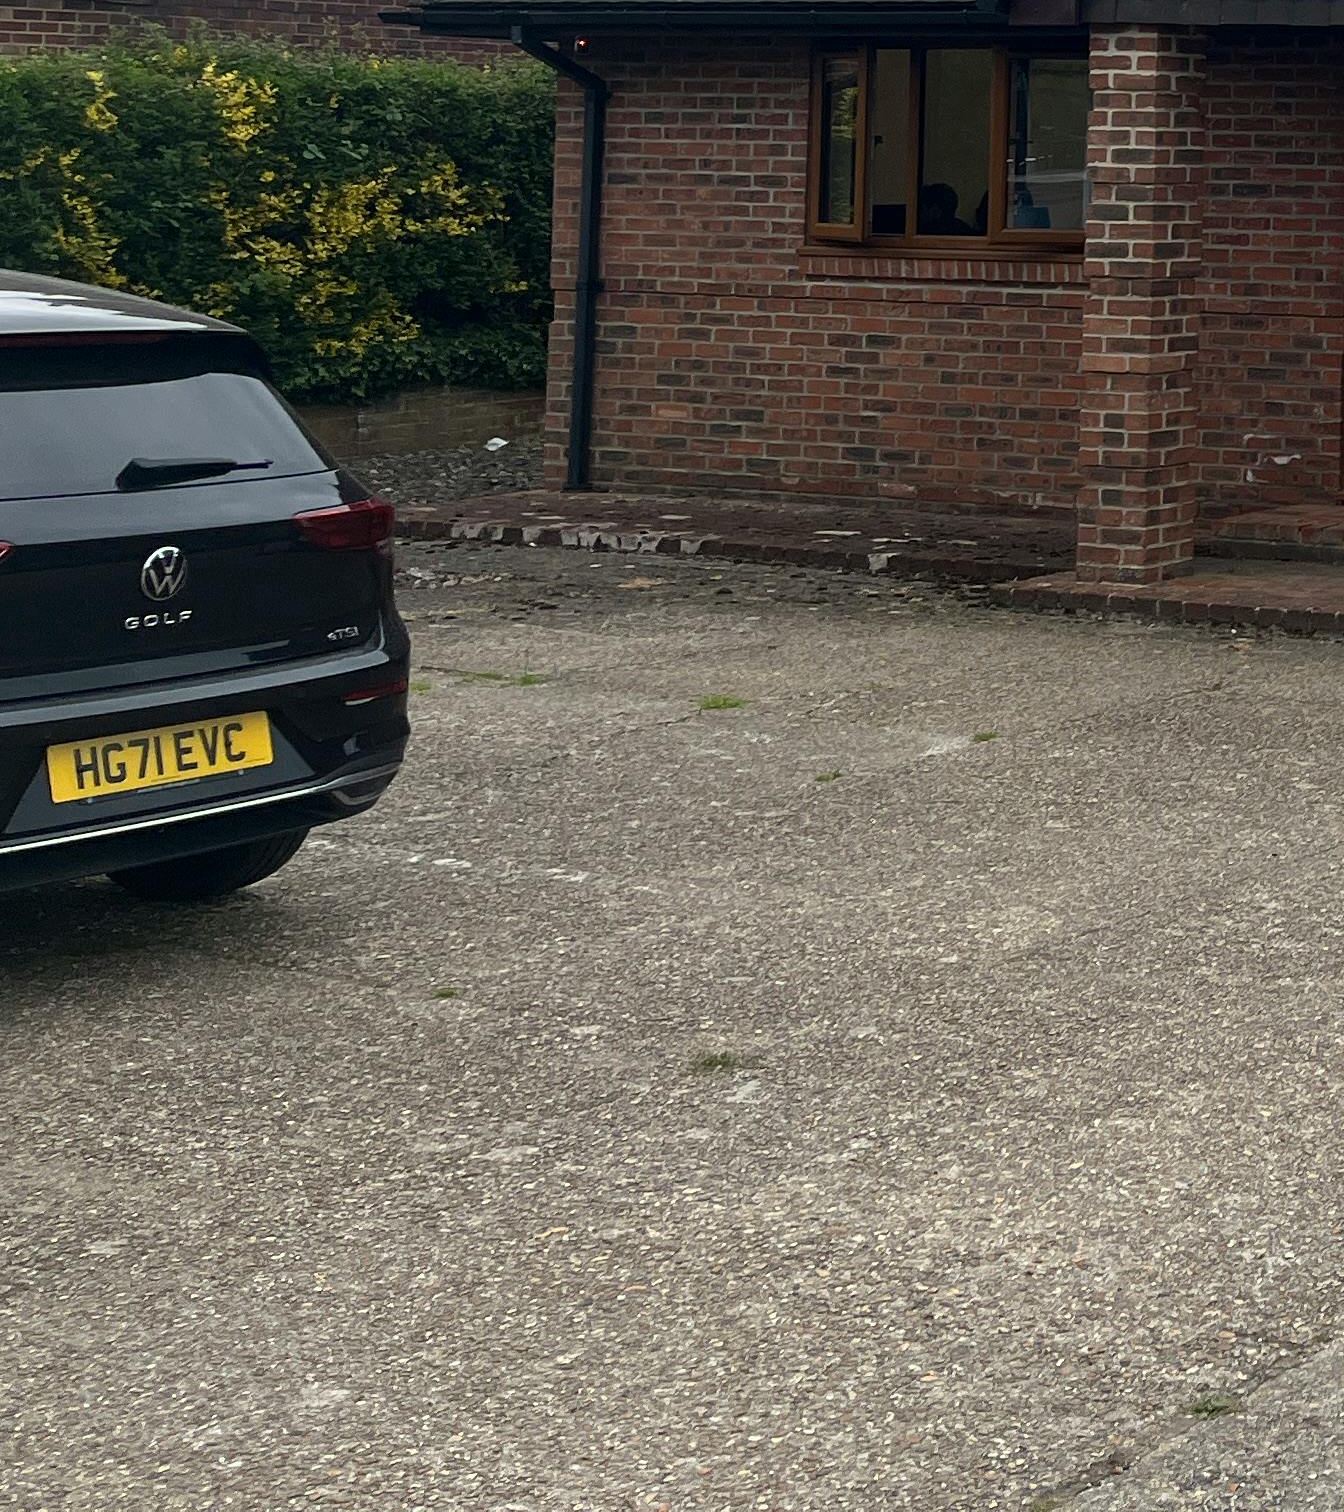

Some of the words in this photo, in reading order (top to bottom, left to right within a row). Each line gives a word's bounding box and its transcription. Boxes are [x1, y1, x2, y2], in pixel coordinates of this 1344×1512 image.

[124, 610, 193, 630] GOLF
[73, 735, 165, 790] HG71
[173, 722, 246, 772] EVC
